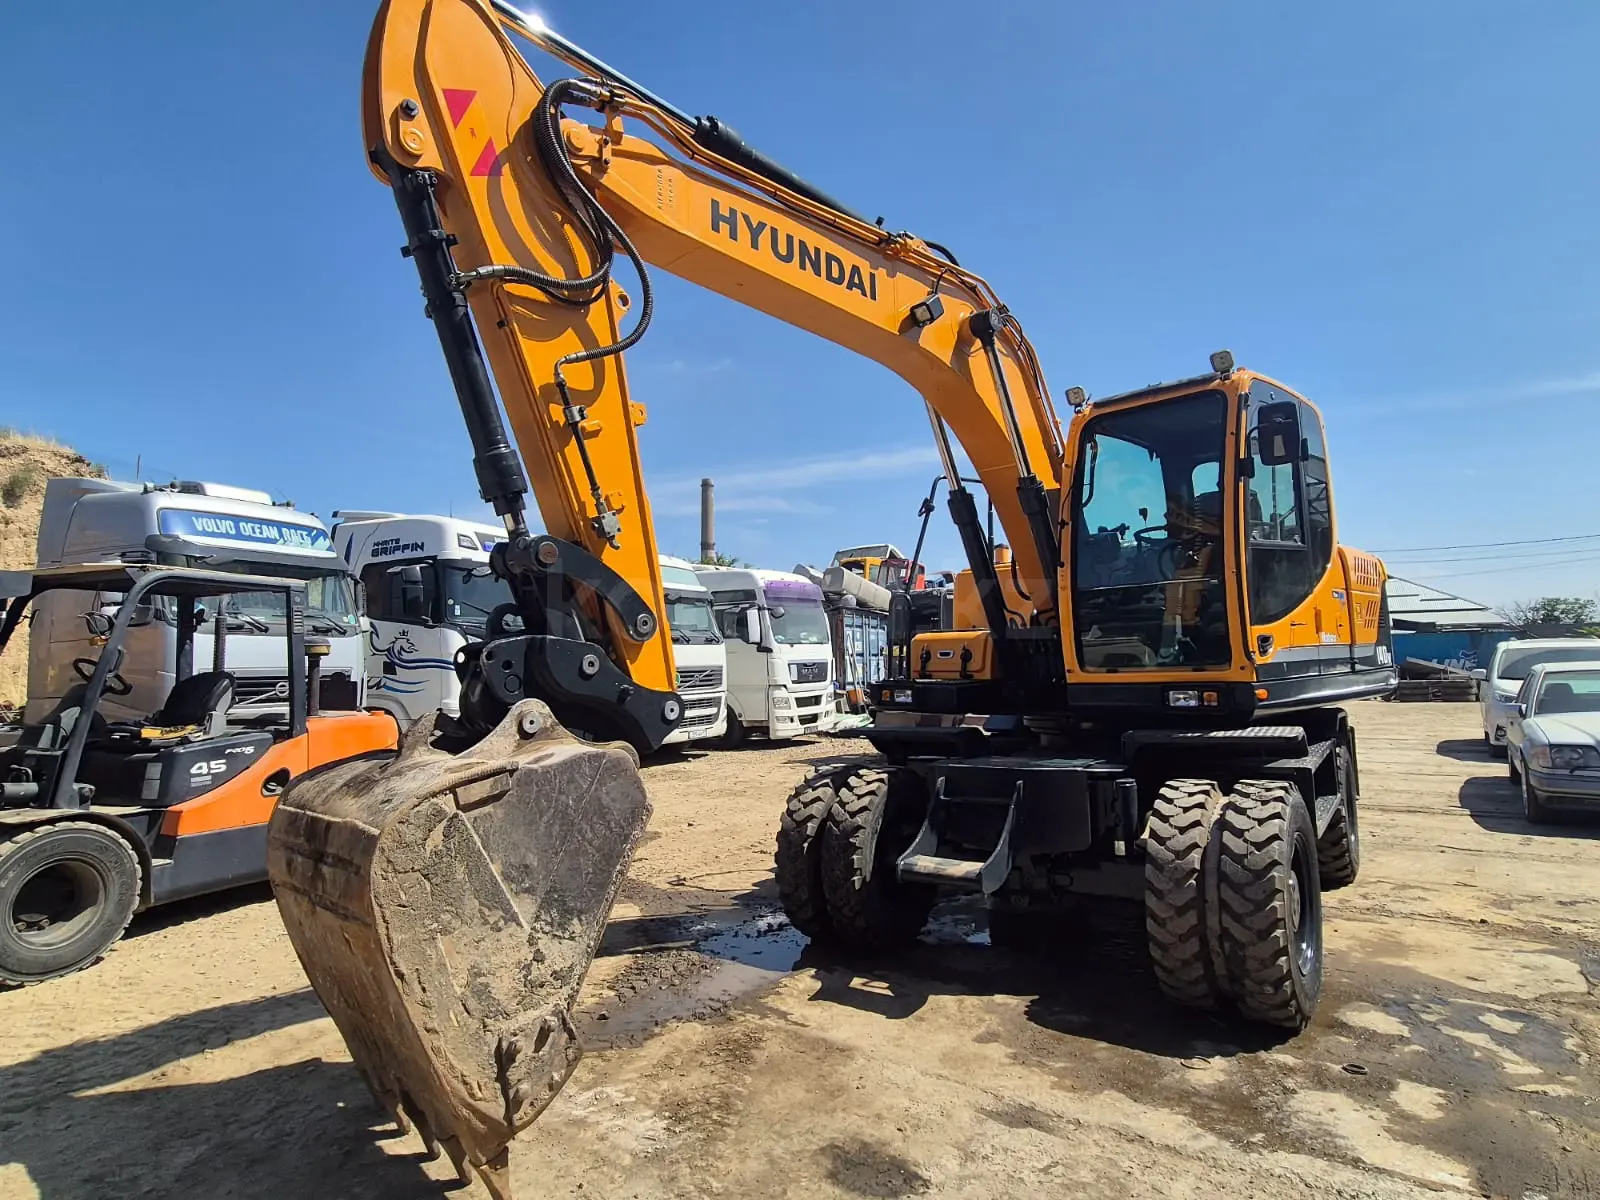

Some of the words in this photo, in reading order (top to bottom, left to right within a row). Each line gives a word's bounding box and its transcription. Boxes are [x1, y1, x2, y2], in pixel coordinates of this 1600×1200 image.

[710, 197, 878, 302] HYUNDAI
[191, 516, 236, 534] VOLVO
[239, 521, 280, 541] OCEAN
[189, 759, 228, 775] 45
